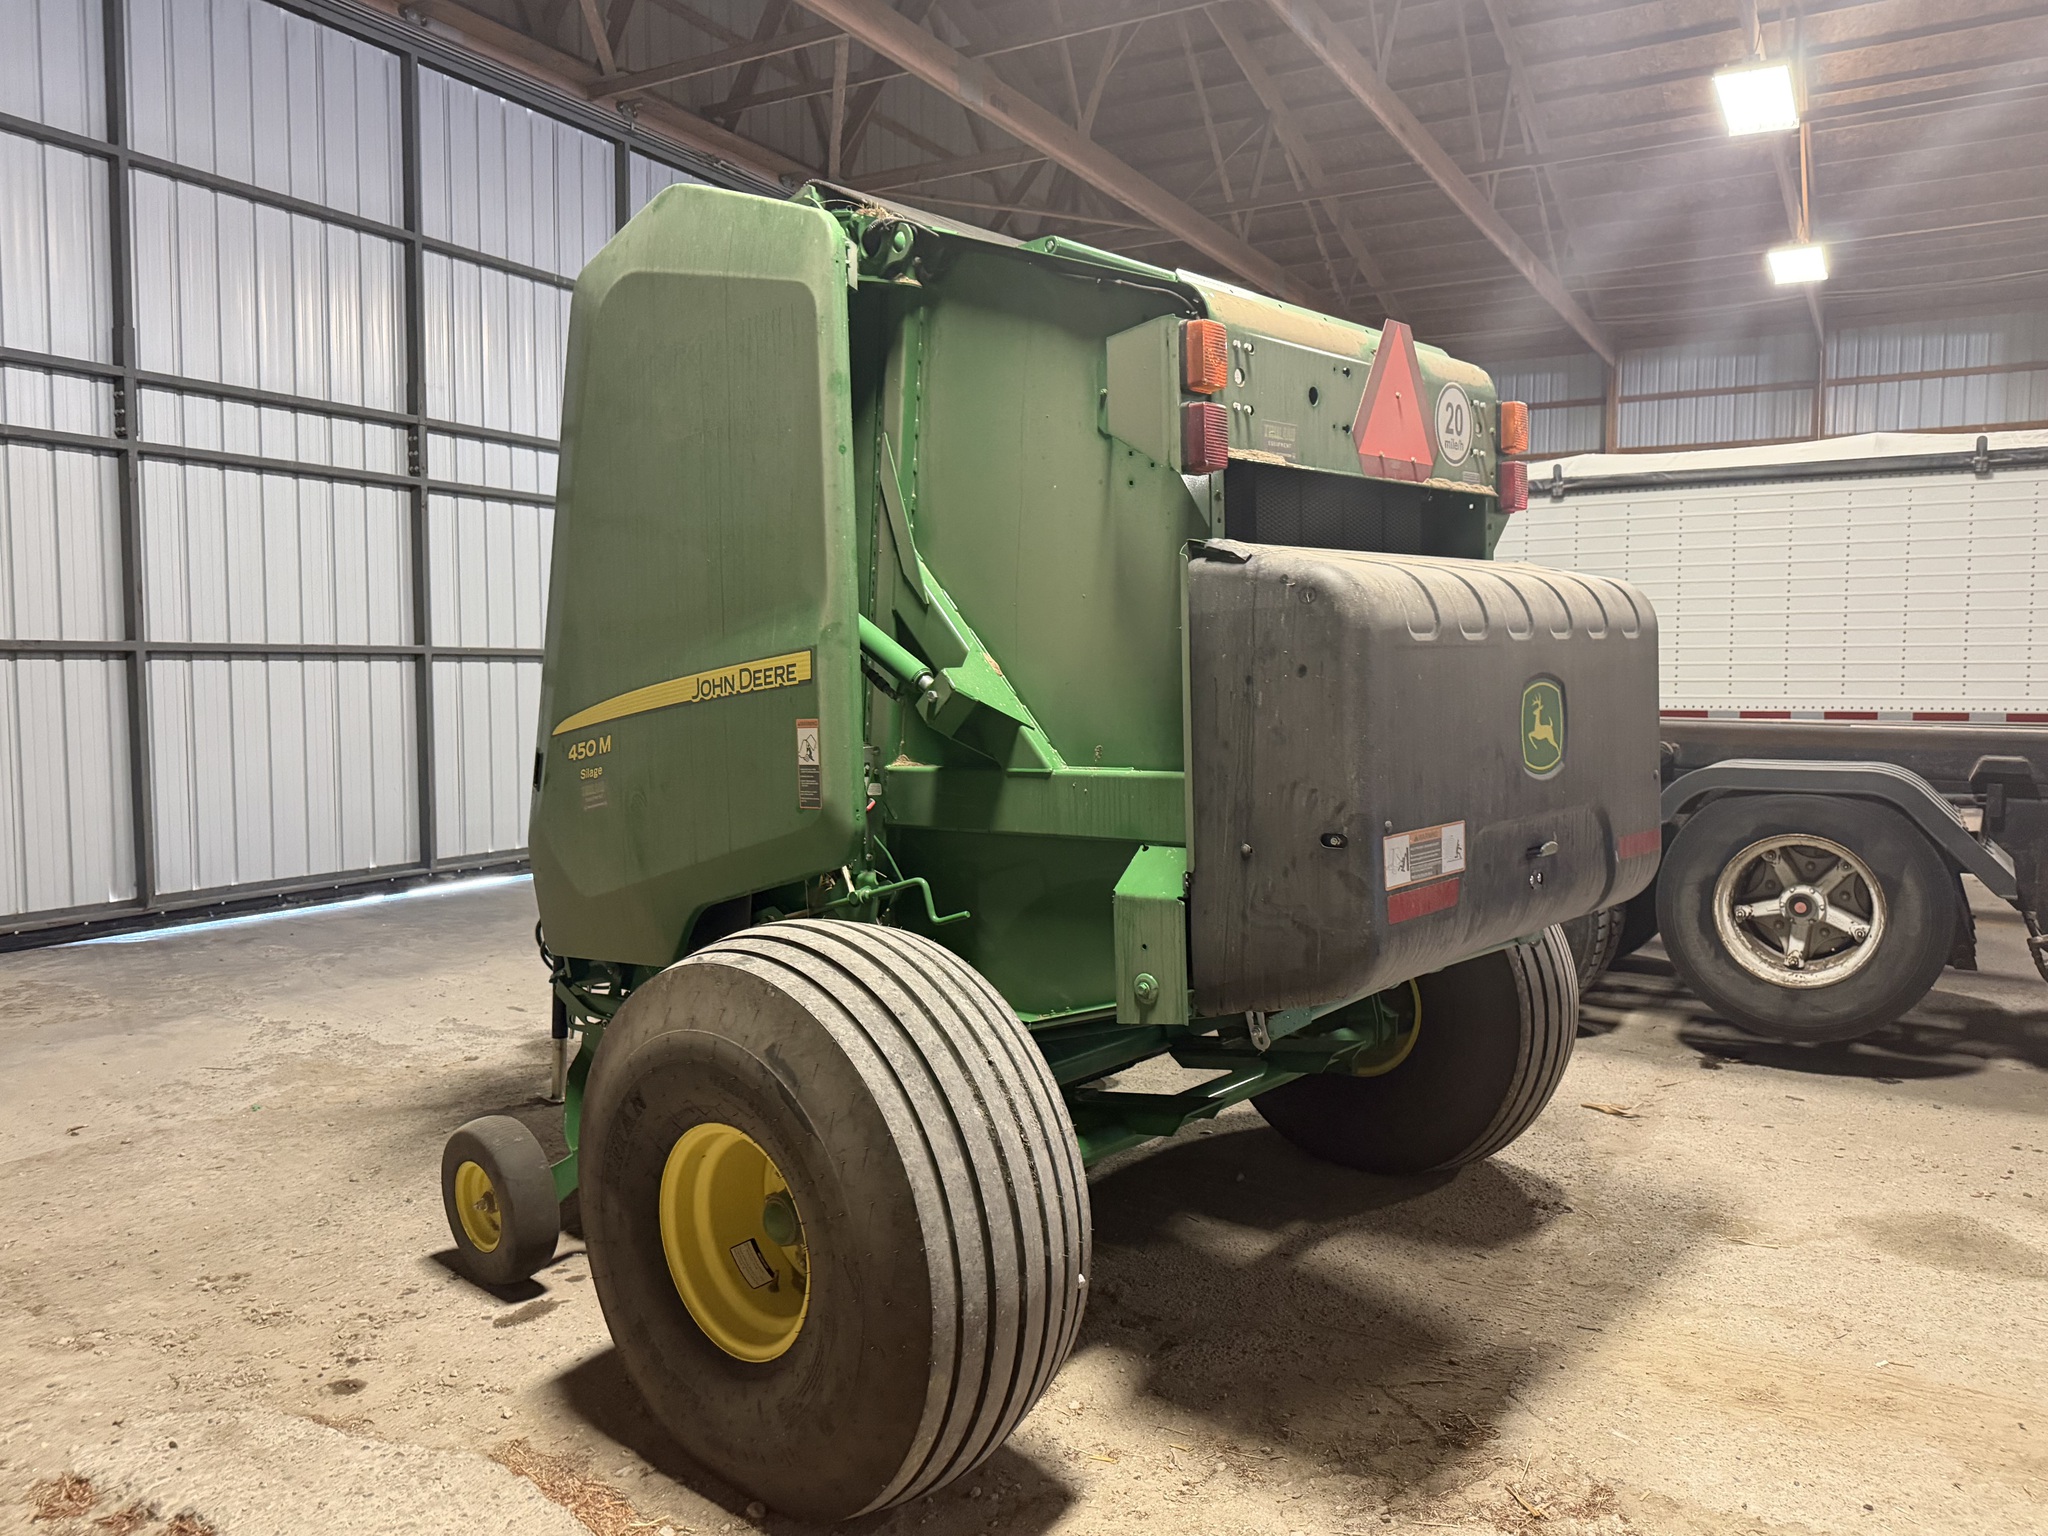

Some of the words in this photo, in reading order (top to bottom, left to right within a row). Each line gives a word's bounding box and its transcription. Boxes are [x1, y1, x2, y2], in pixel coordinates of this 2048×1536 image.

[1445, 402, 1463, 436] 20
[692, 674, 735, 699] JOHN
[739, 663, 797, 690] DEERE
[568, 739, 597, 761] 450
[599, 734, 611, 755] M
[580, 766, 603, 780] Silage
